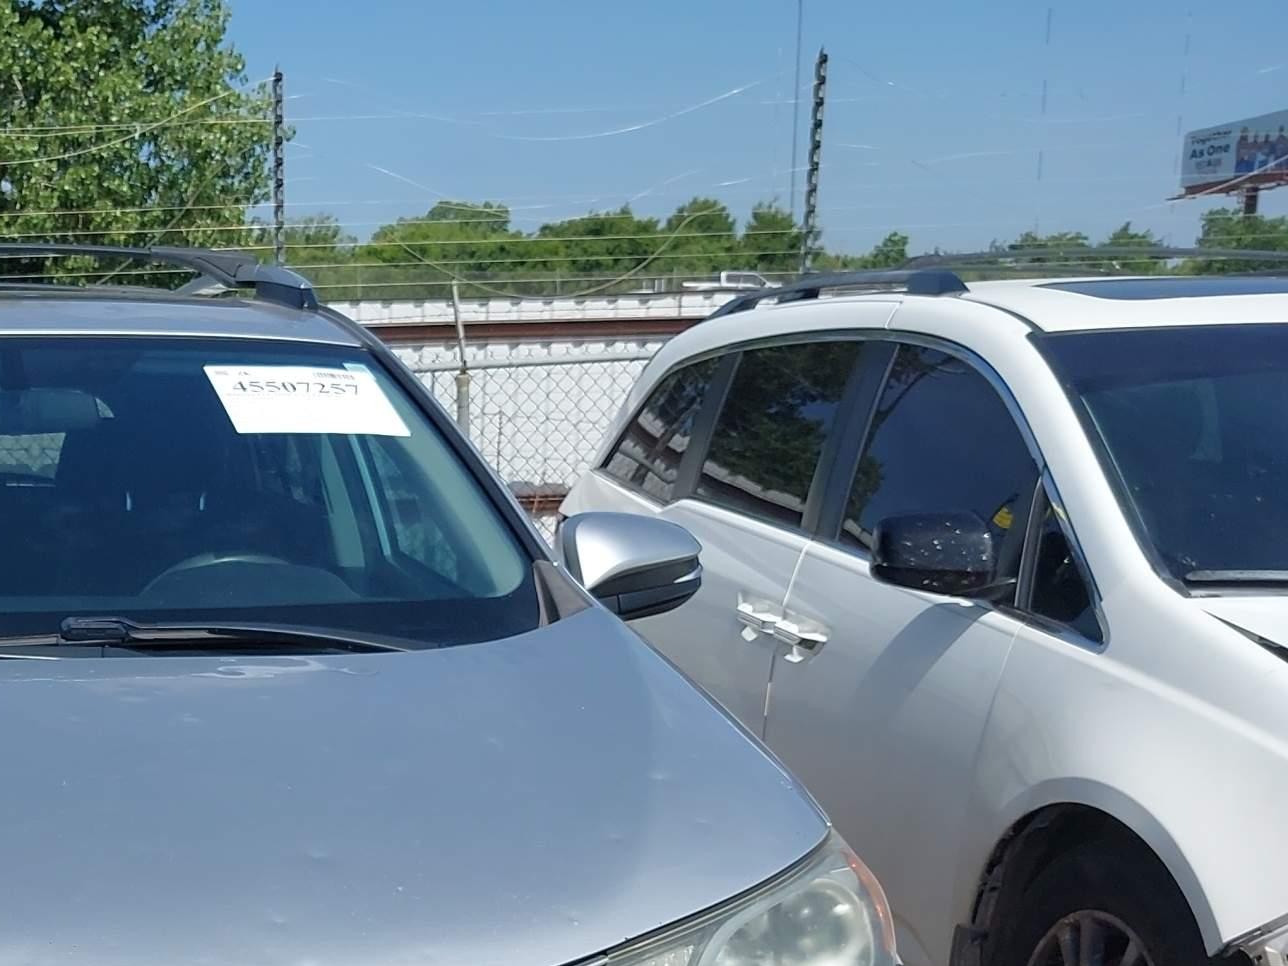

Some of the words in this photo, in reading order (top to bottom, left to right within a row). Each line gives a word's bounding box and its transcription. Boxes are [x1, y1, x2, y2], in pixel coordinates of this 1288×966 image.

[1189, 148, 1205, 160] As
[1206, 144, 1231, 157] One
[232, 380, 359, 396] 45507257
